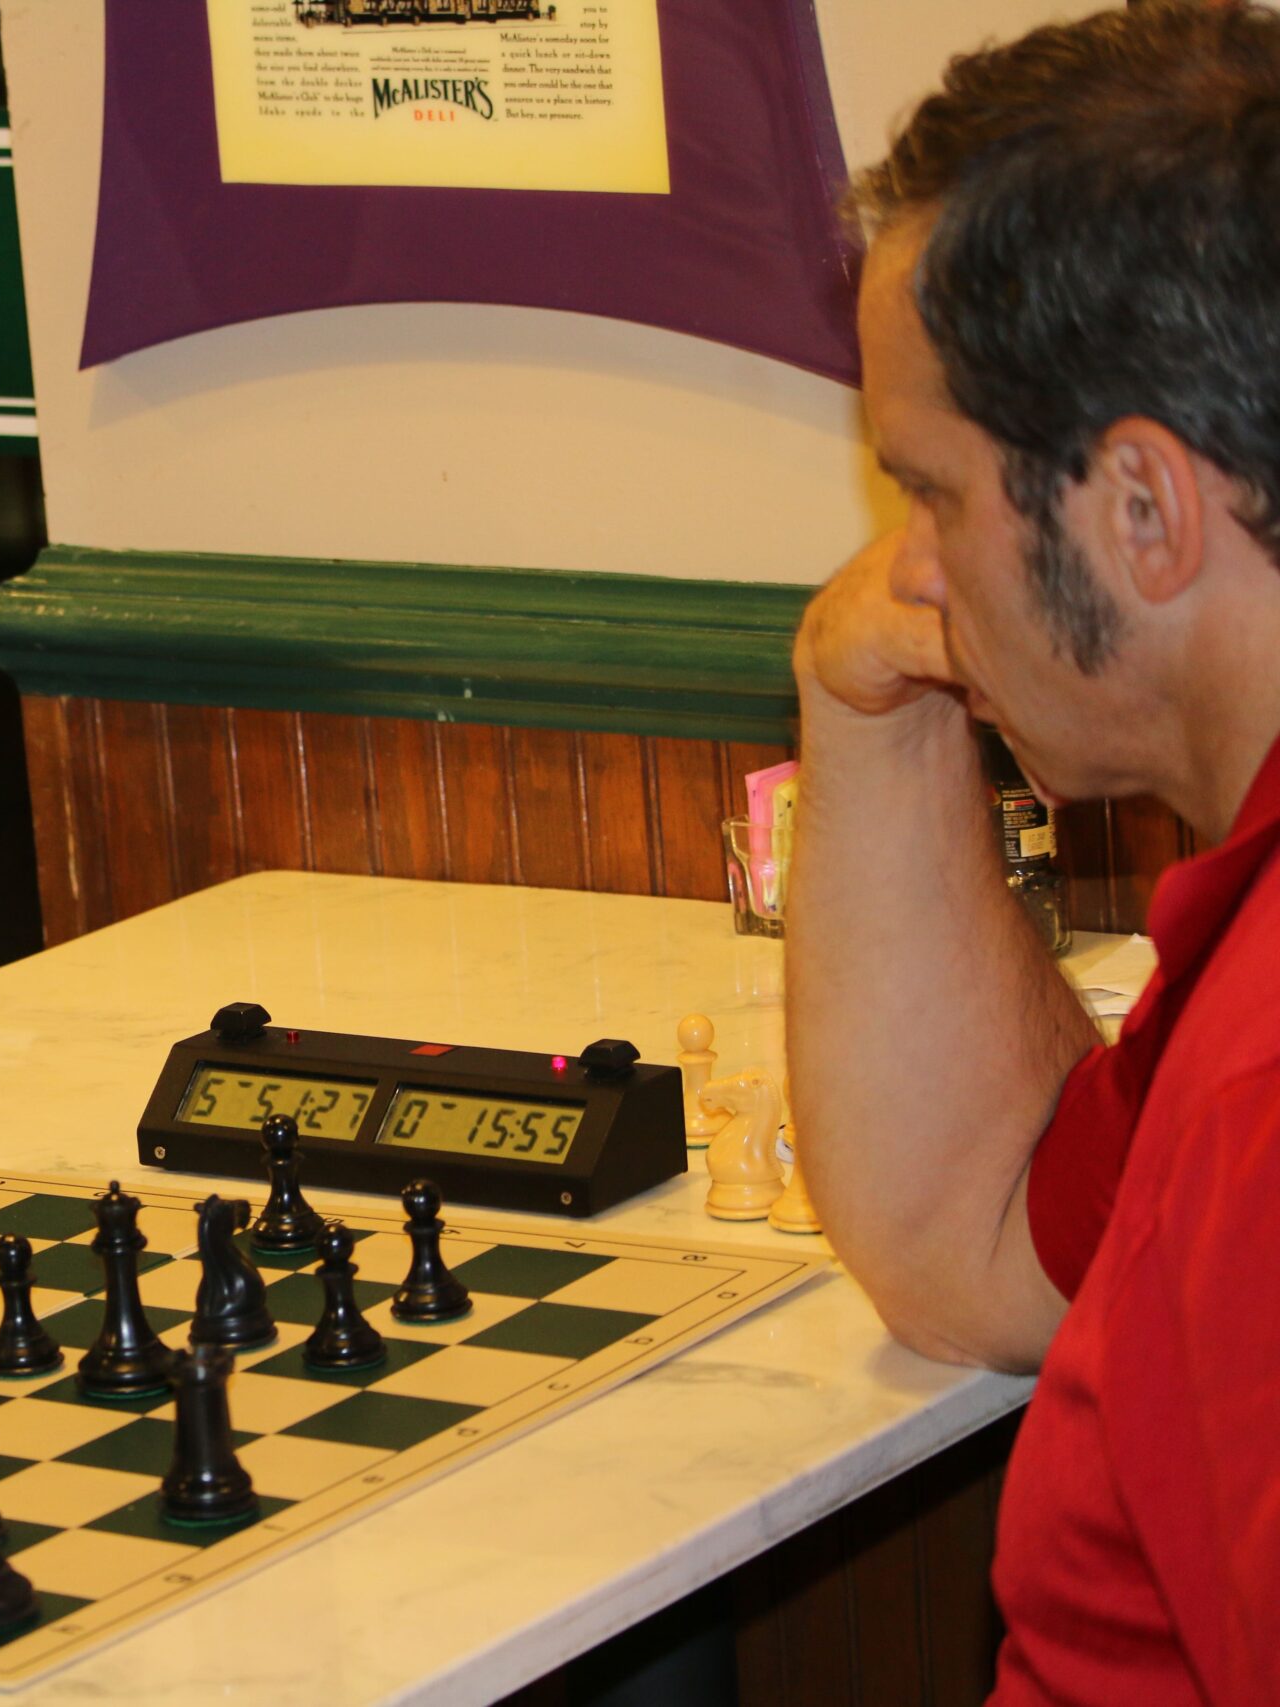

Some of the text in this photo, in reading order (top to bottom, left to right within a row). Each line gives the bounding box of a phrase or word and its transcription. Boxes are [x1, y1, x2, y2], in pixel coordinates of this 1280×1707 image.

[580, 19, 608, 30] stop by
[510, 48, 531, 59] quick
[535, 49, 558, 58] lunch
[529, 63, 543, 73] The
[562, 65, 596, 74] sandwich
[597, 65, 612, 74] that
[518, 79, 537, 88] order
[539, 79, 558, 88] could
[570, 80, 582, 89] the
[598, 80, 613, 89] that
[371, 76, 494, 120] McALISTER'S
[553, 94, 573, 105] place
[414, 110, 455, 122] DELI
[564, 1240, 587, 1249] 7
[682, 1253, 708, 1263] 8
